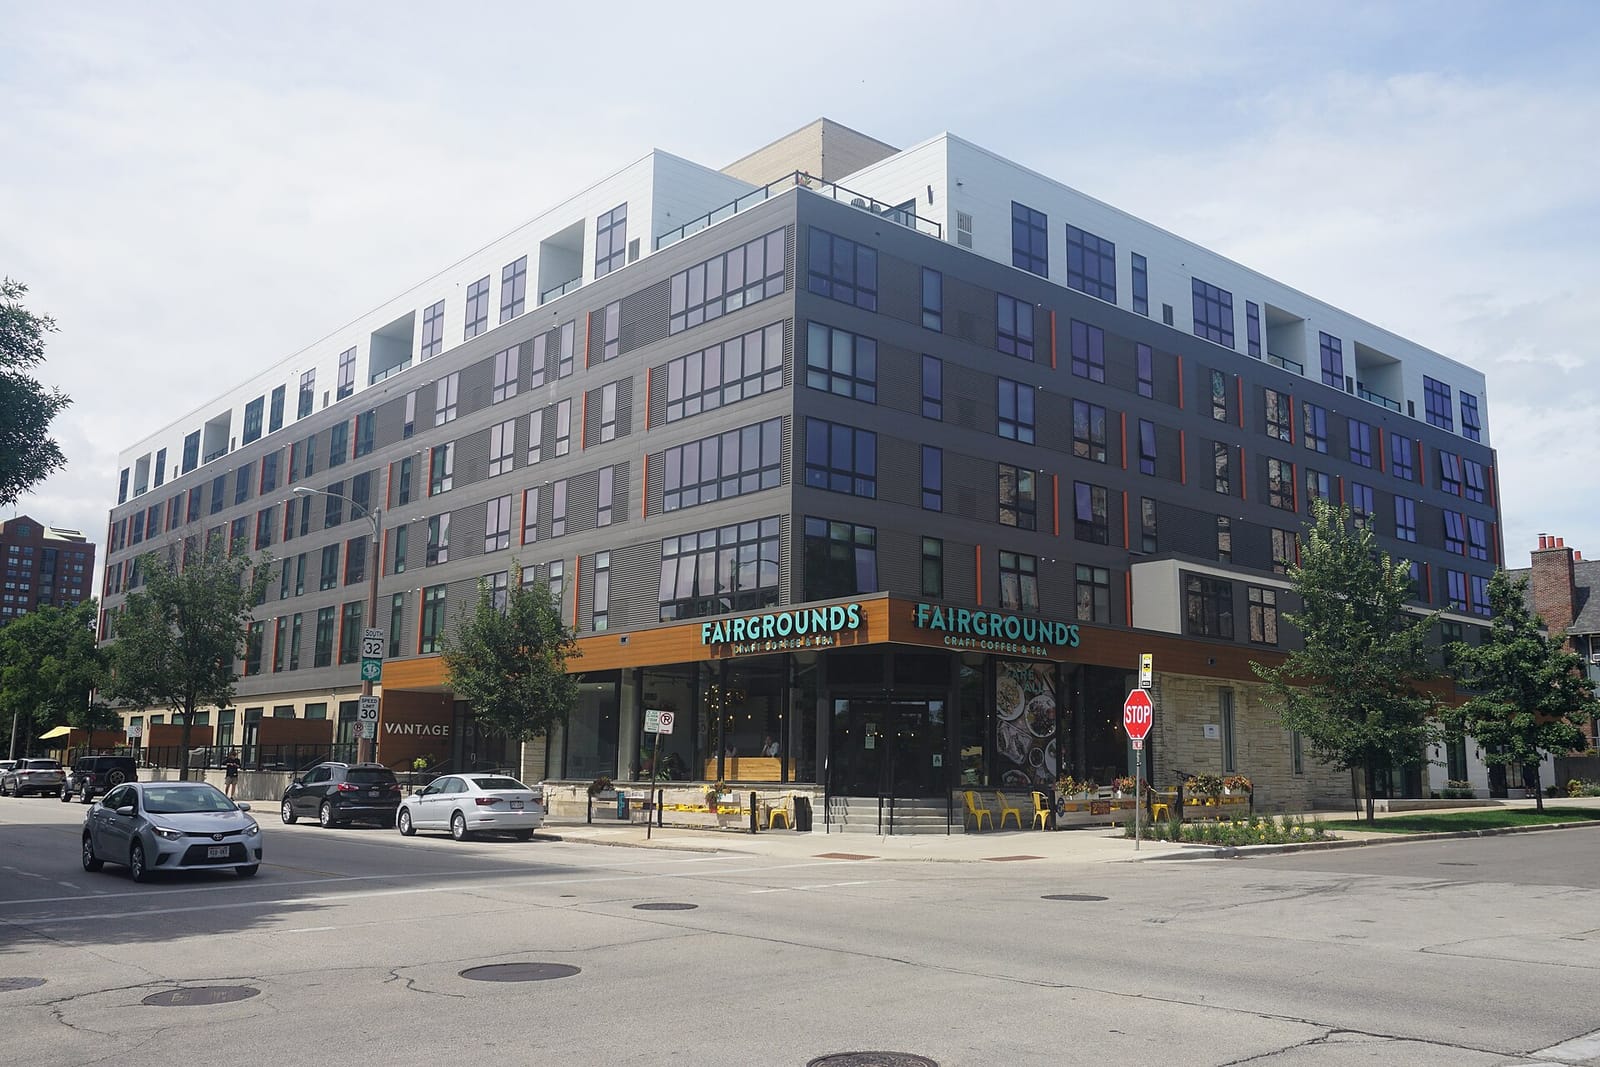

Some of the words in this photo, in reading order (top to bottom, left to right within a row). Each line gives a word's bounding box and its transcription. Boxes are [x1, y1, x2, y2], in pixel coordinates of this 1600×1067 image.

[365, 629, 383, 637] SOUTH
[701, 603, 860, 645] FAIRGROUNDS
[917, 603, 1080, 647] FAIRGROUNDS
[365, 642, 381, 655] 32
[734, 642, 761, 653] CRAFT
[765, 639, 801, 651] COFFEE
[805, 637, 811, 647] &
[815, 635, 833, 645] TEA
[944, 635, 976, 648] CRAFT
[980, 639, 1017, 653] COFFEE
[1021, 644, 1027, 654] &
[1031, 646, 1048, 656] TEA
[360, 709, 376, 719] 30
[1125, 705, 1151, 724] STOP
[385, 722, 449, 736] VANTAGE
